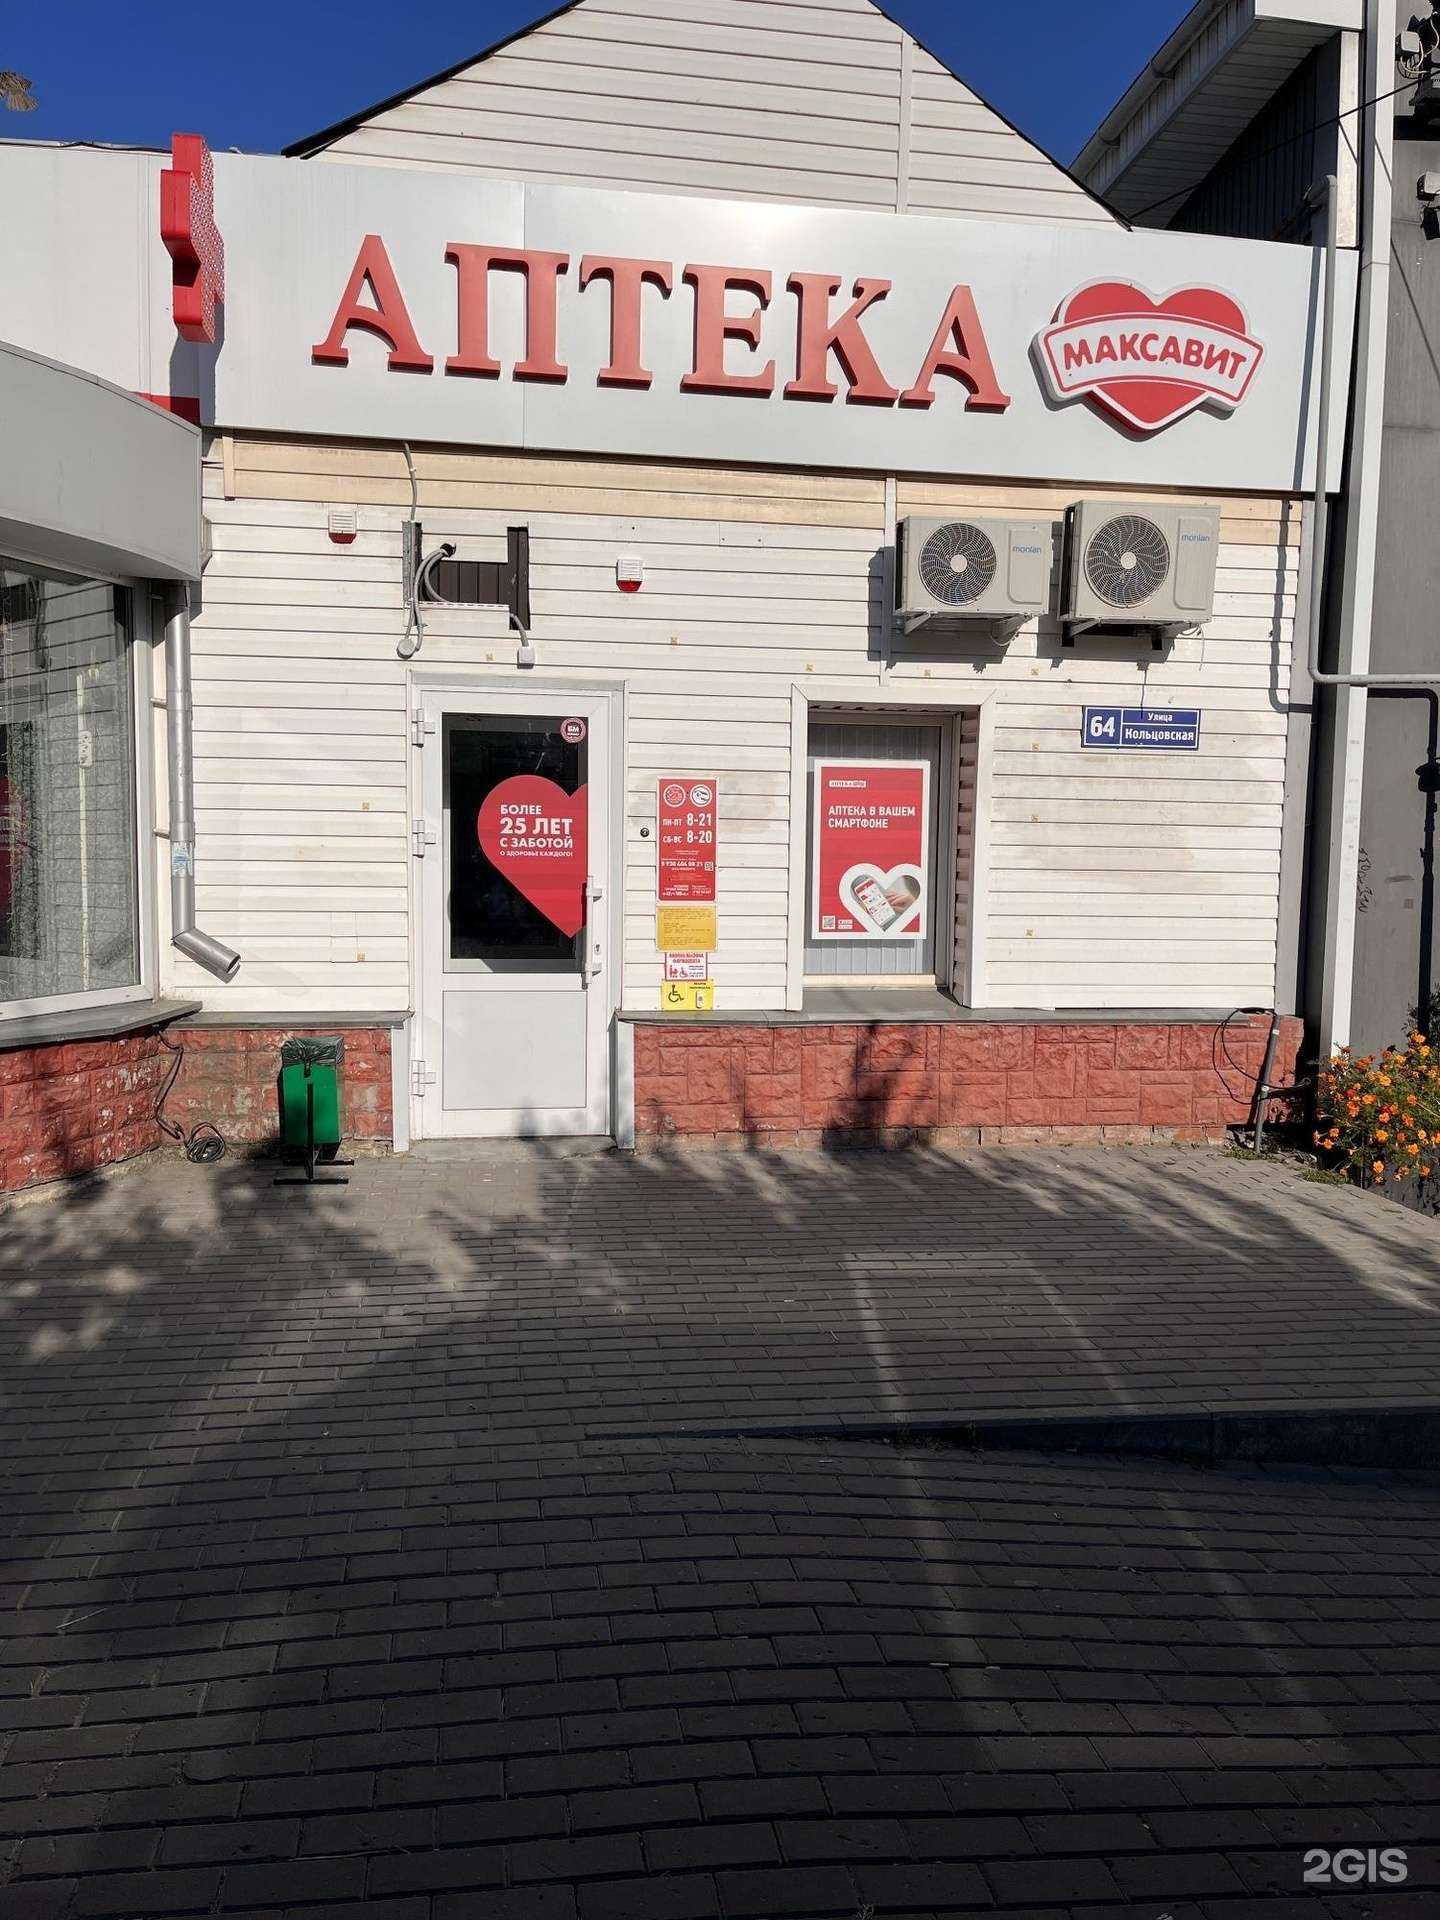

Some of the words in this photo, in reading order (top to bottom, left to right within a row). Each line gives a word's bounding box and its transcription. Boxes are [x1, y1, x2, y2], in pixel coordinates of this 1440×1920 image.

[311, 234, 1011, 414] АПТЕКА
[1063, 333, 1247, 379] МАКСАВИТ
[1147, 712, 1173, 722] Улица
[1090, 716, 1115, 737] 64
[1125, 728, 1194, 741] Кольцовская
[500, 804, 542, 815] БОЛЕЕ
[828, 806, 867, 816] АПТЕКА
[869, 806, 876, 816] В
[878, 806, 916, 816] ВАШЕМ
[687, 812, 712, 826] 8-21
[828, 818, 889, 829] СМАРТФОНЕ
[500, 817, 527, 834] 25
[532, 818, 573, 835] ЛЕТ
[499, 837, 508, 848] С
[511, 836, 573, 849] ЗАБОТОЙ
[662, 835, 683, 844] СБ-ВС
[687, 830, 712, 844] 8-20
